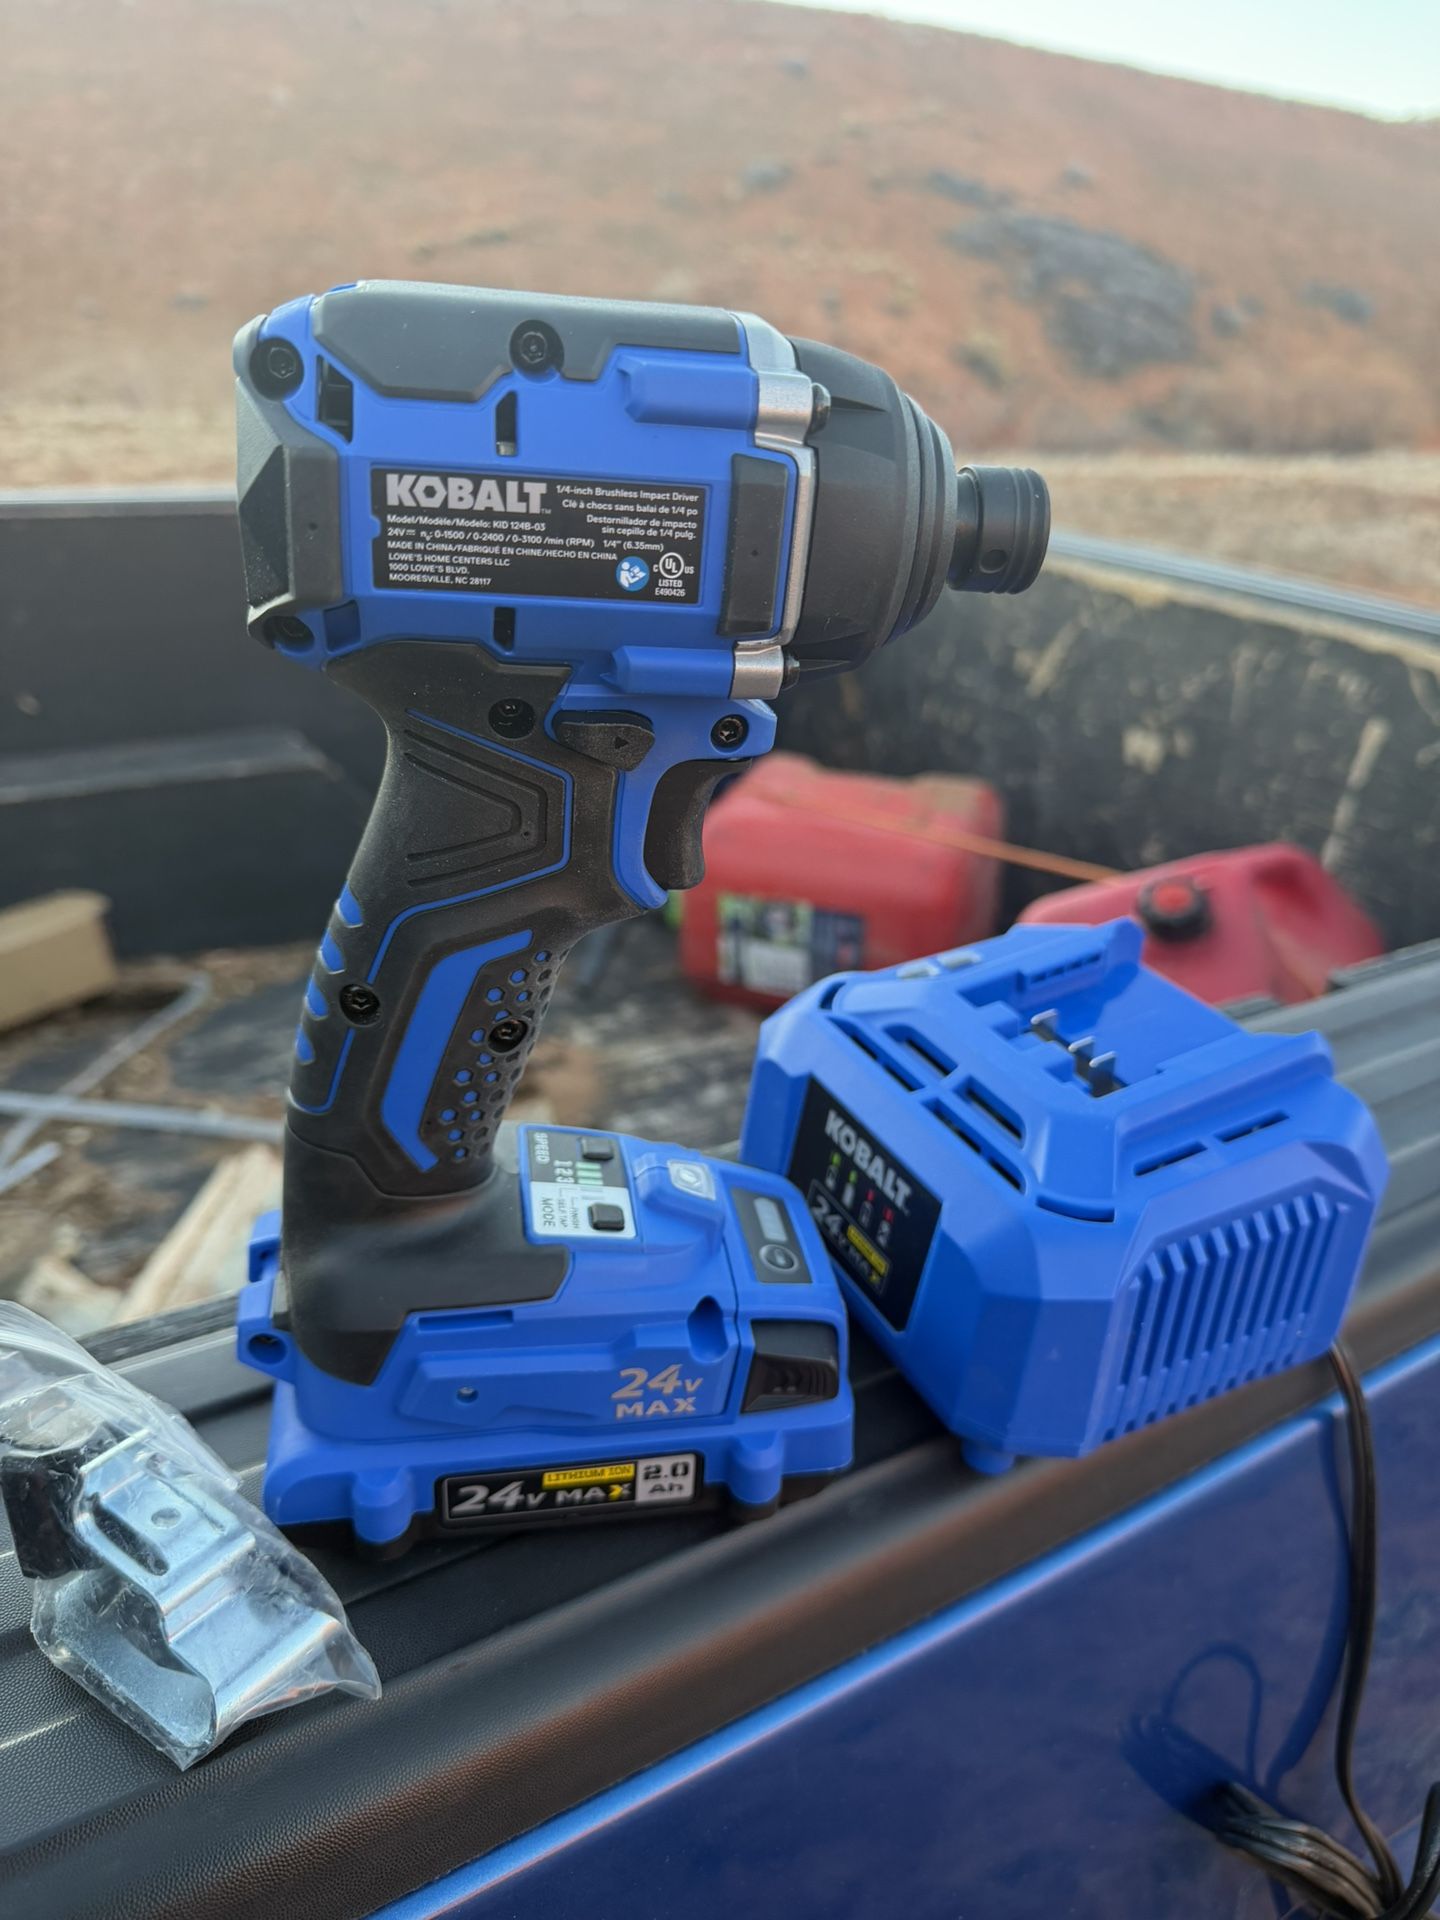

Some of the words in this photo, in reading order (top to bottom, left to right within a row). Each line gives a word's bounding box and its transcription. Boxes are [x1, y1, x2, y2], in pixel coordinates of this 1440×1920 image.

[386, 474, 547, 514] KOBALT
[556, 485, 593, 496] 1/4-inch
[595, 487, 639, 498] Brushless
[640, 490, 670, 501] Impact
[672, 492, 699, 502] Driver
[586, 500, 613, 510] chocs
[614, 503, 635, 512] sans
[636, 502, 657, 513] balai
[658, 504, 670, 514] de
[671, 506, 685, 515] 1/4
[686, 508, 698, 517] po
[493, 521, 508, 529] KID
[586, 514, 648, 526] Destornillador
[649, 517, 661, 527] de
[662, 519, 697, 530] impacto
[434, 530, 465, 540] 0-1500
[473, 532, 504, 542] 0-2400
[512, 533, 542, 544] 0-3100
[543, 536, 564, 545] /min
[566, 537, 595, 548] (RPM)
[623, 540, 664, 552] (6.35mm)
[602, 525, 615, 534] sin
[616, 526, 645, 538] cepillo
[646, 527, 658, 536] de
[659, 528, 673, 537] 1/4
[674, 529, 696, 541] pulg.
[387, 541, 413, 550] MADE
[415, 542, 424, 550] IN
[502, 546, 514, 555] EN
[516, 547, 576, 559] CHINE/HECHO
[578, 551, 589, 559] EN
[591, 552, 617, 561] CHINA
[388, 553, 423, 562] LOWE'S
[424, 554, 450, 563] HOME
[452, 556, 493, 565] CENTERS
[494, 558, 510, 567] LLC
[388, 563, 409, 571] 1000
[410, 564, 444, 573] LOWE'S
[445, 566, 470, 575] BLVD.
[455, 577, 468, 585] NC
[469, 577, 492, 586] 28117
[658, 579, 683, 587] LISTED
[655, 587, 686, 597] E490426
[534, 1132, 550, 1164] SPEED
[824, 1109, 912, 1208] KOBALT
[554, 1168, 573, 1176] 2
[541, 1197, 556, 1227] MODE
[615, 1396, 697, 1418] MAX
[546, 1467, 601, 1483] LITHIUM
[605, 1465, 632, 1478] ION
[643, 1461, 690, 1481] 2.0
[555, 1482, 632, 1506] MAX
[648, 1481, 685, 1494] Ah
